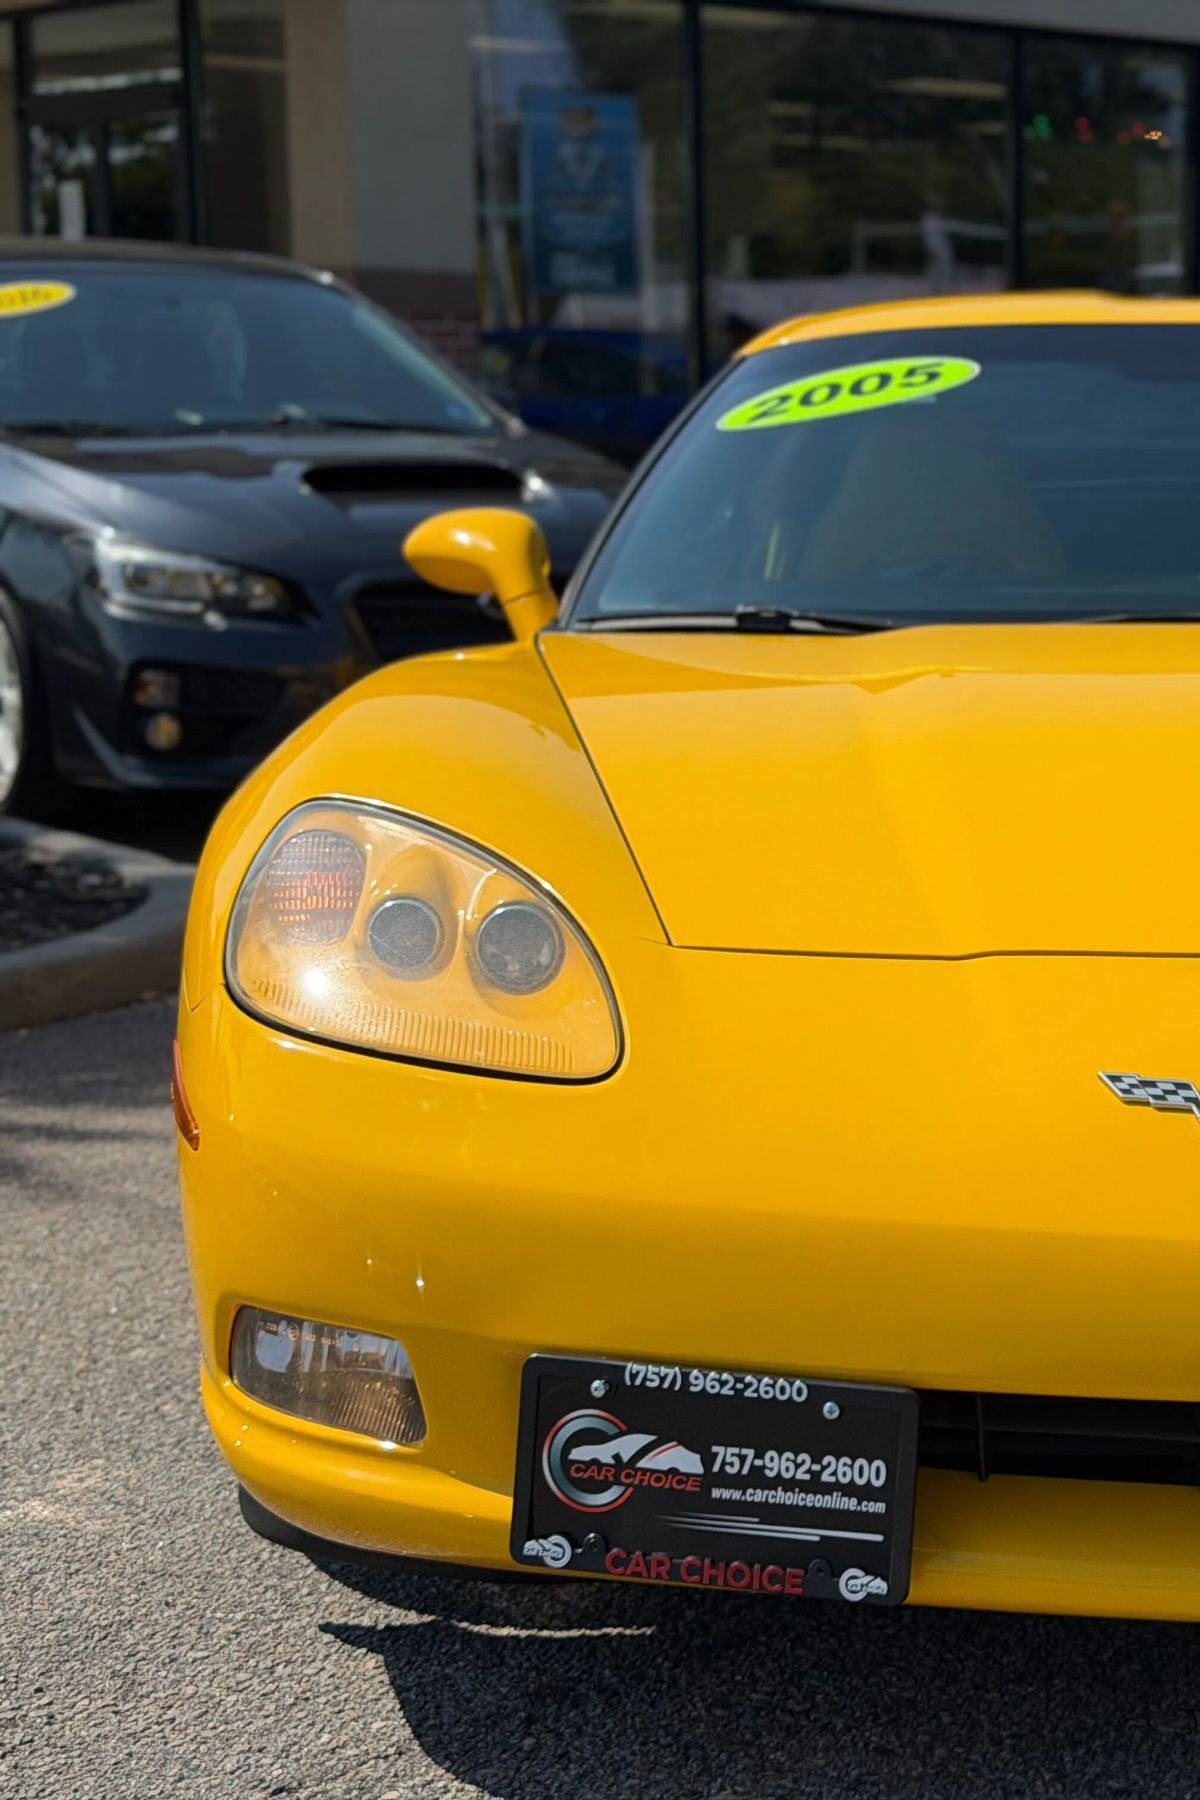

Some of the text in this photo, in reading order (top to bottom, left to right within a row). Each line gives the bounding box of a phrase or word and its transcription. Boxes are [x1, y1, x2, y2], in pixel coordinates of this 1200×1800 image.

[746, 361, 945, 424] 2005
[624, 1361, 808, 1402] (757) 962-2600
[570, 1463, 703, 1492] CAR CHOICE
[711, 1445, 887, 1488] 757-962-2600
[711, 1486, 886, 1514] www.carchoiceonline.com
[605, 1547, 805, 1594] CAR CHOICE
